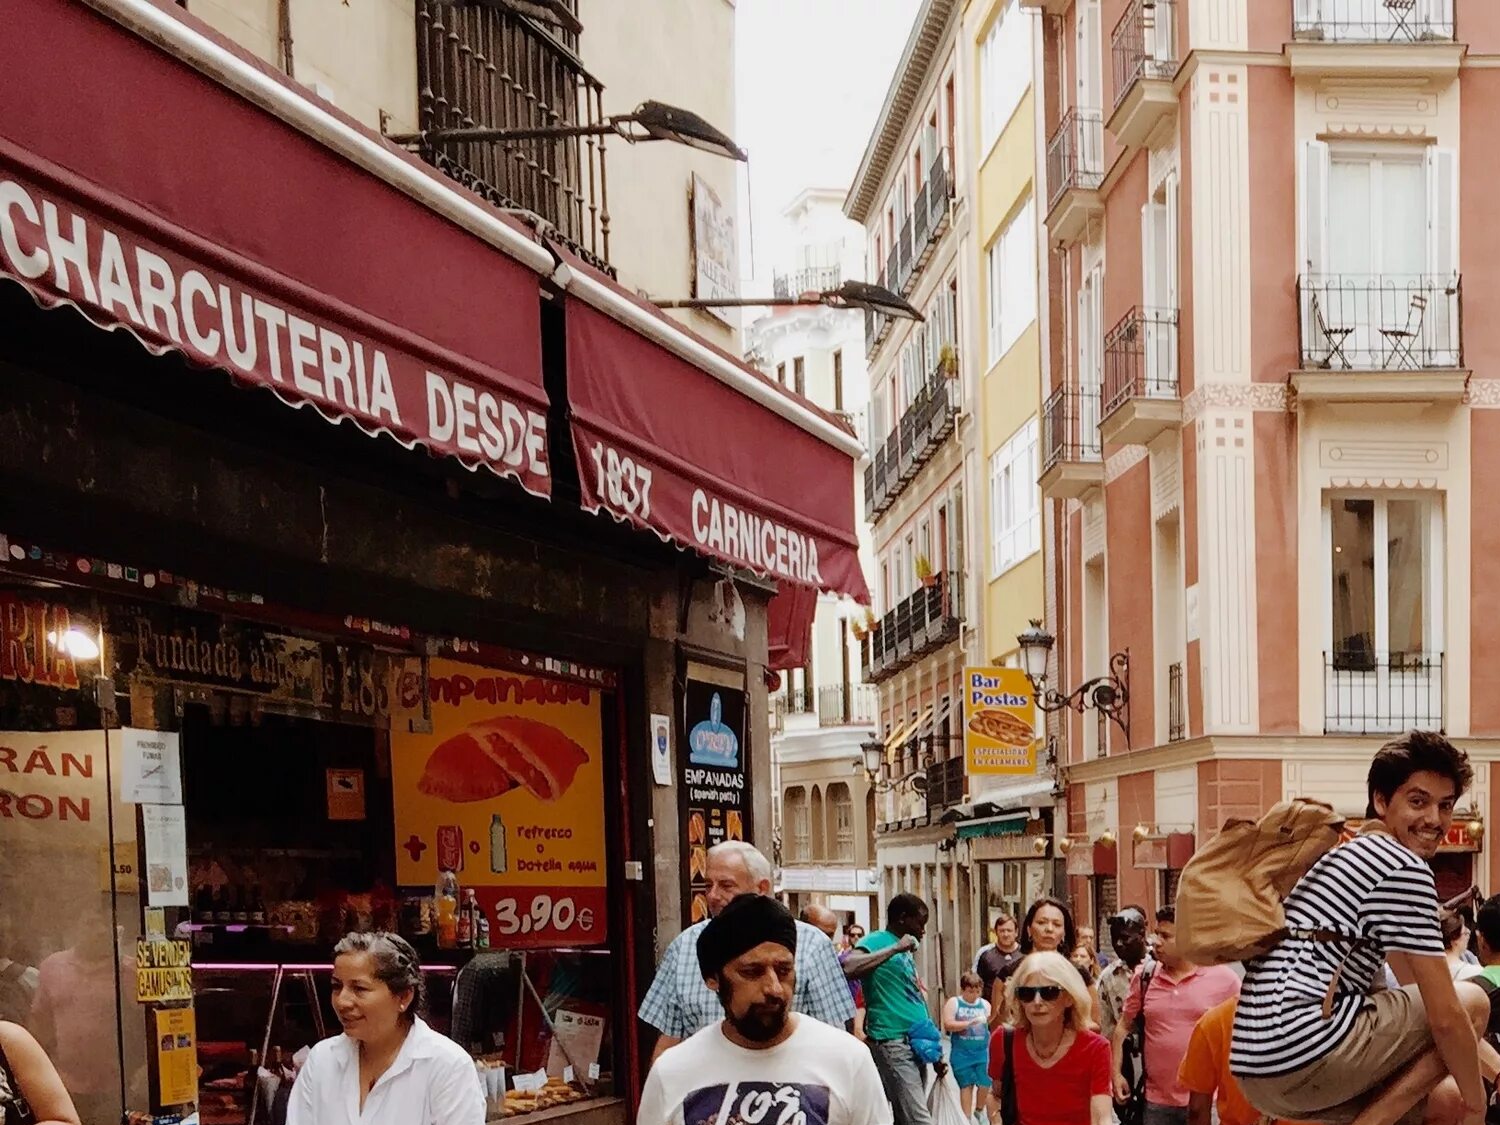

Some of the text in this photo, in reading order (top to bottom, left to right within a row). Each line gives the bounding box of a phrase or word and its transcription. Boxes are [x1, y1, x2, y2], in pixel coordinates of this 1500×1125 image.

[0, 180, 549, 476] CHARCUTERIA DESDE
[591, 442, 824, 583] 1837 CARNICERIA
[971, 674, 1000, 688] Bar
[972, 691, 1028, 706] Postas
[685, 768, 744, 789] EMPANADAS
[495, 895, 593, 934] 3,90€
[137, 939, 191, 968] SE VENDEN
